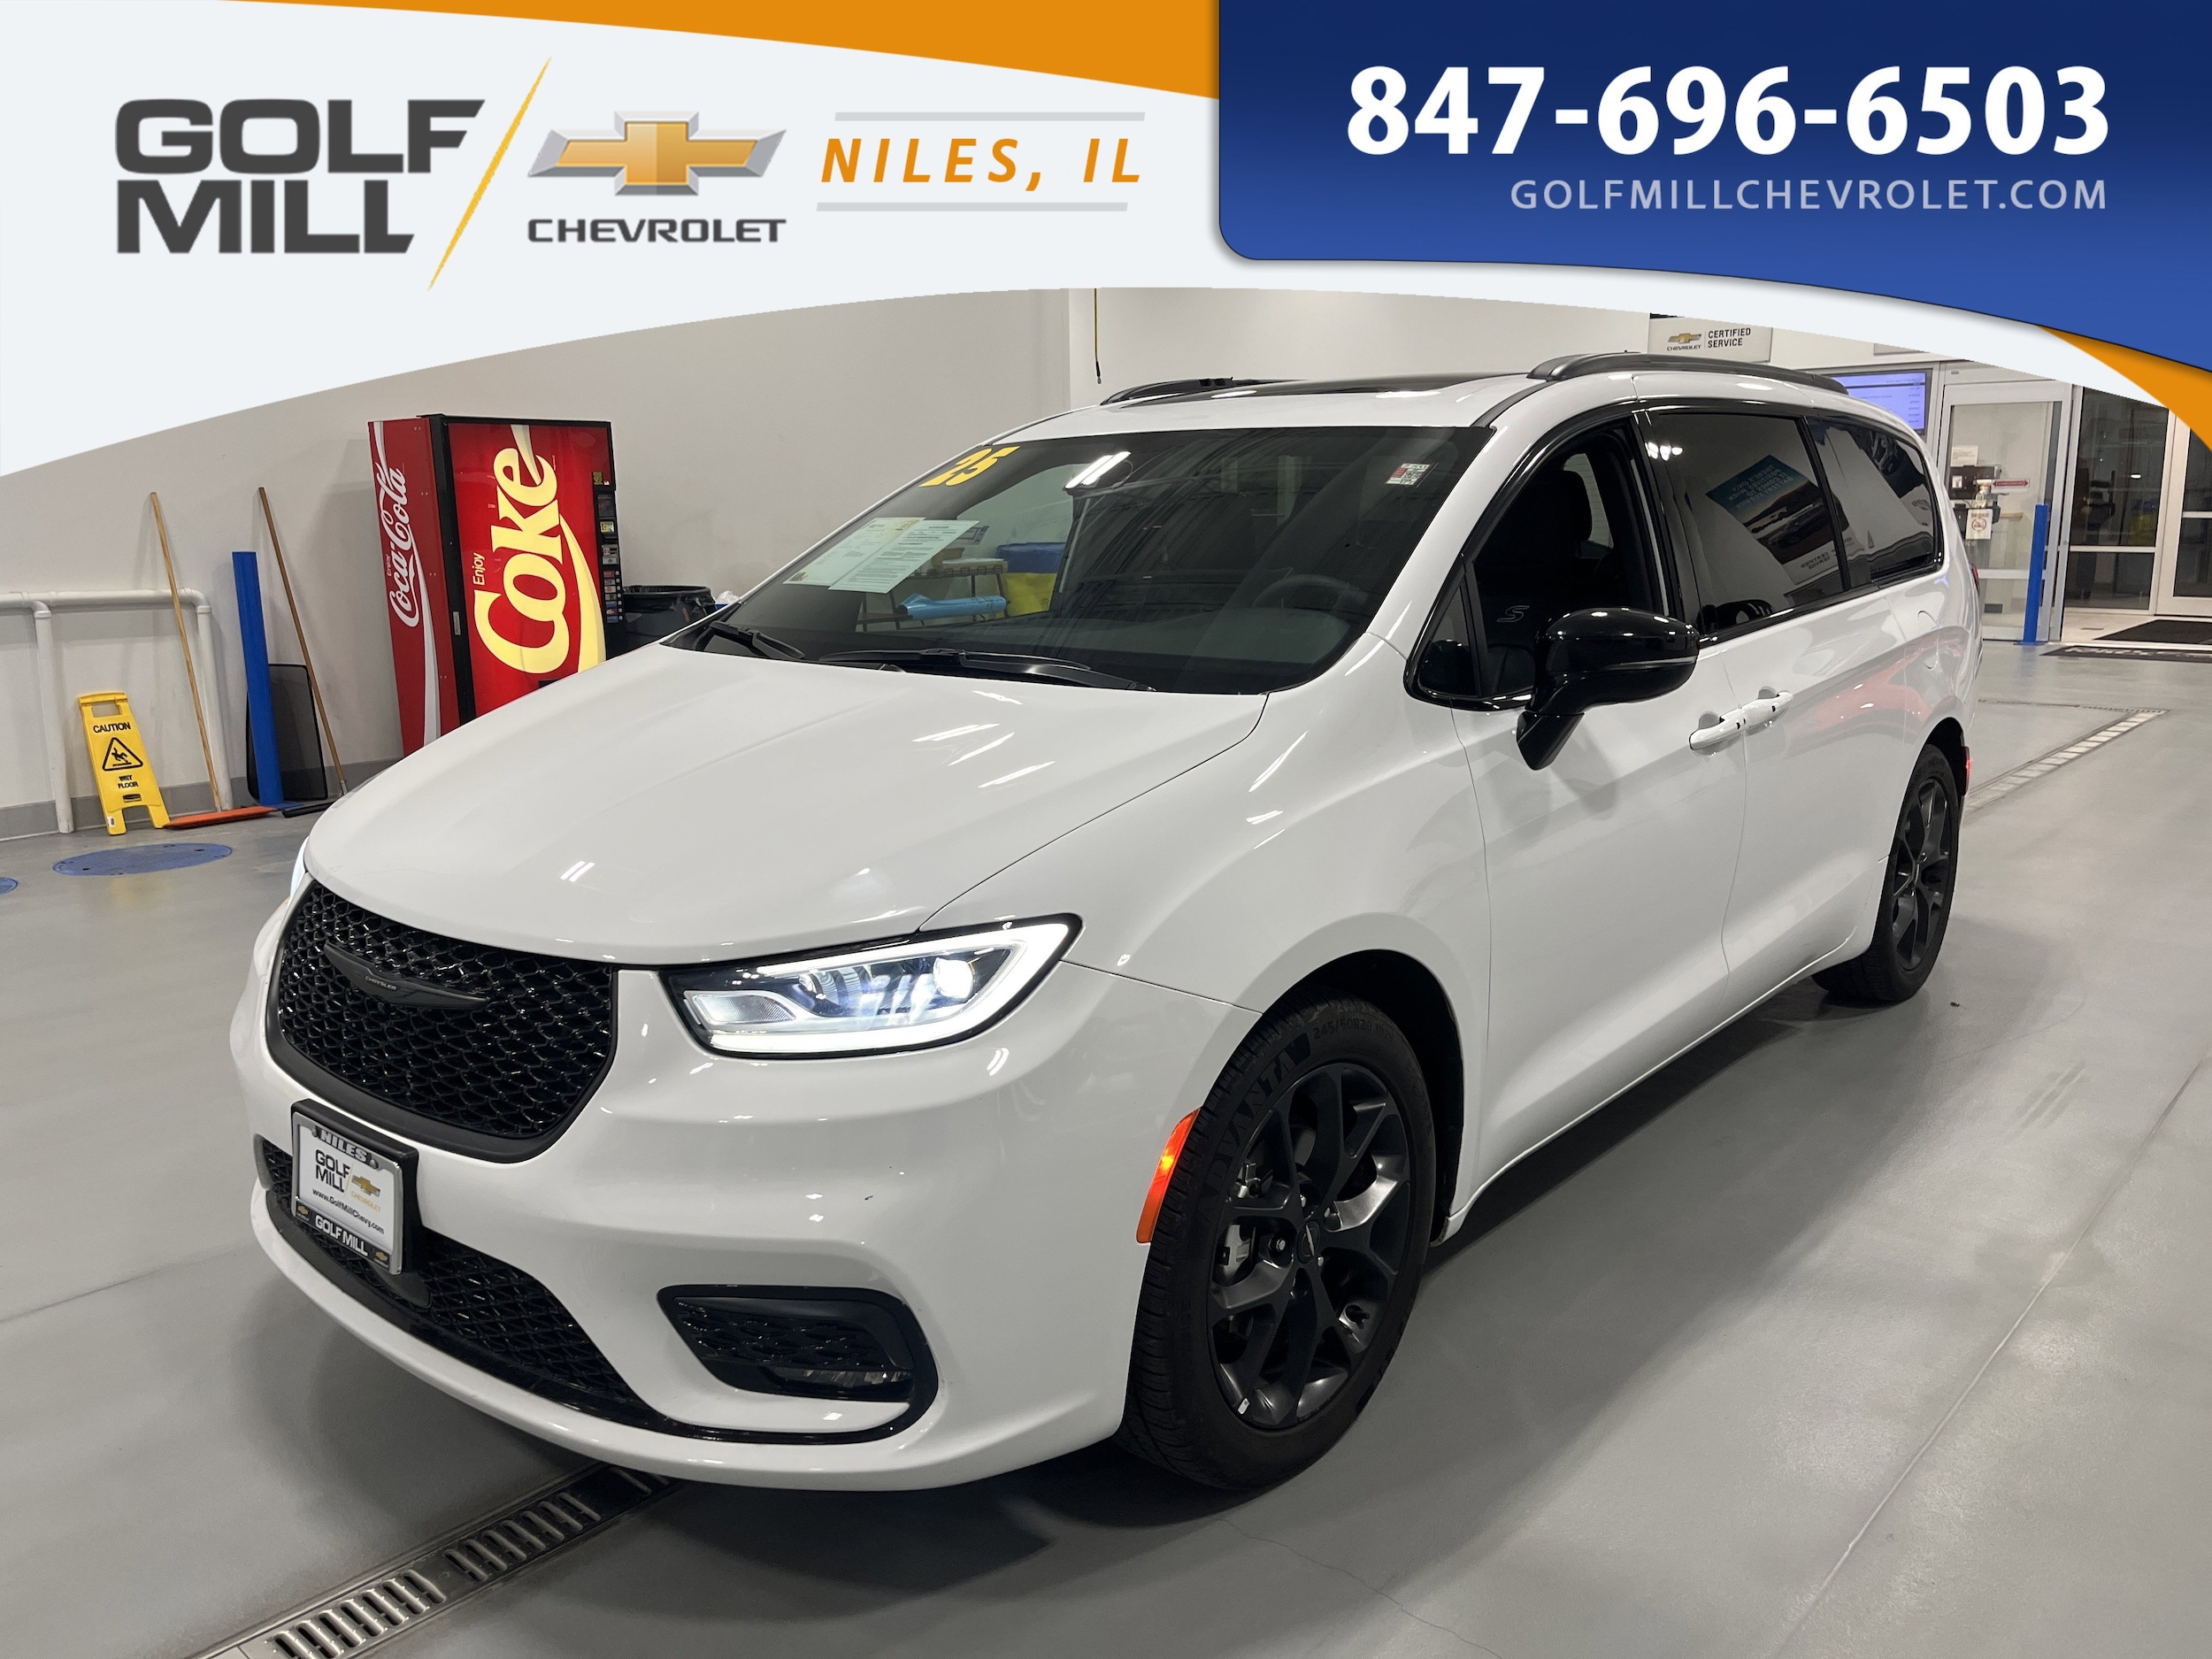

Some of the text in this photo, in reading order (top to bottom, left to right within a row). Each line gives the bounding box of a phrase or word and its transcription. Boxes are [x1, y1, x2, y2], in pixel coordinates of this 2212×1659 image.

[1708, 327, 1751, 339] CERTIFIED
[1708, 338, 1743, 349] SERVICE
[918, 445, 1020, 488] 25
[473, 447, 570, 673] Coke
[473, 552, 486, 586] Enjoy
[93, 721, 131, 733] CAUTION
[364, 975, 398, 991] CHRYSLER
[320, 1128, 368, 1163] NILES
[315, 1149, 351, 1179] GOLF
[315, 1164, 345, 1193] MILL
[315, 1215, 369, 1256] GOLF MILL
